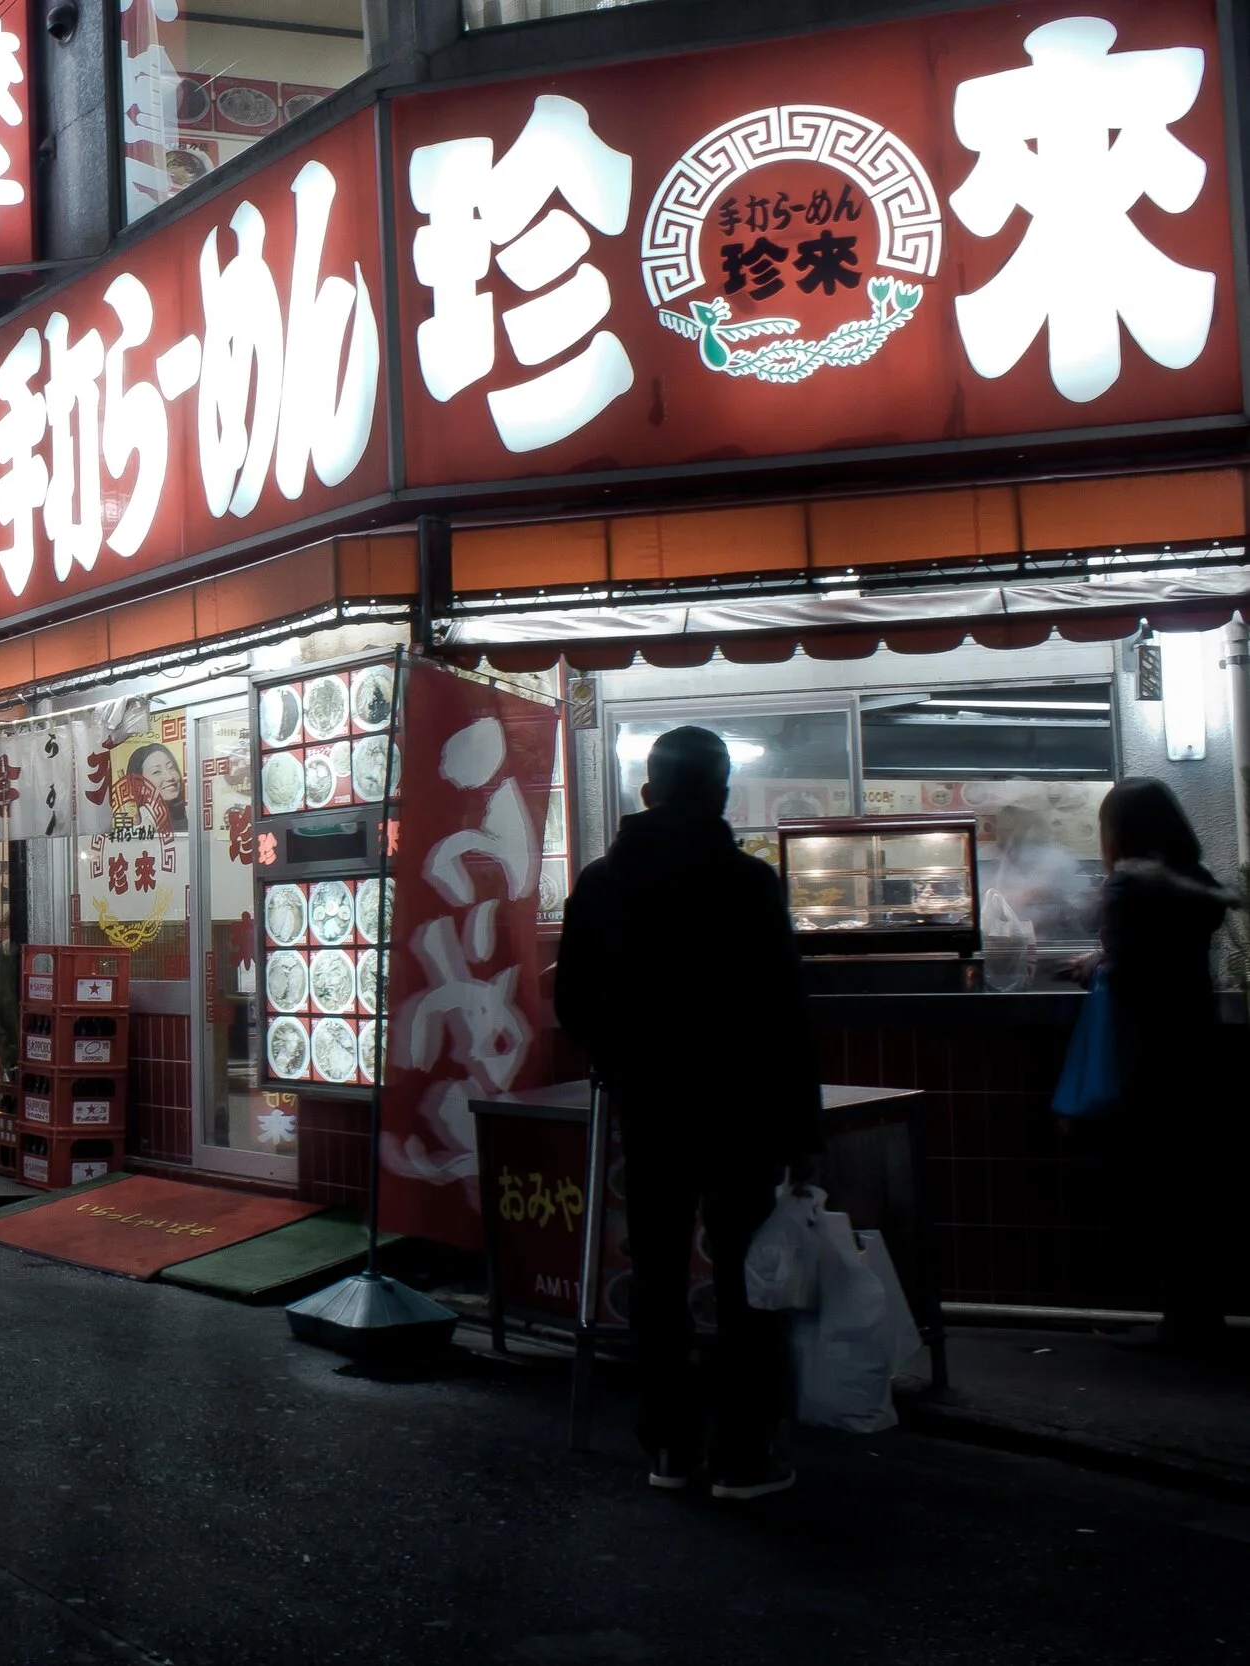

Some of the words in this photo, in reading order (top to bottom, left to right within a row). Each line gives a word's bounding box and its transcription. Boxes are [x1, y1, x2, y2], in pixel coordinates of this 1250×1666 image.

[718, 183, 863, 237] 手打らーめん
[408, 93, 634, 454] 珍
[498, 1164, 584, 1233] おみや
